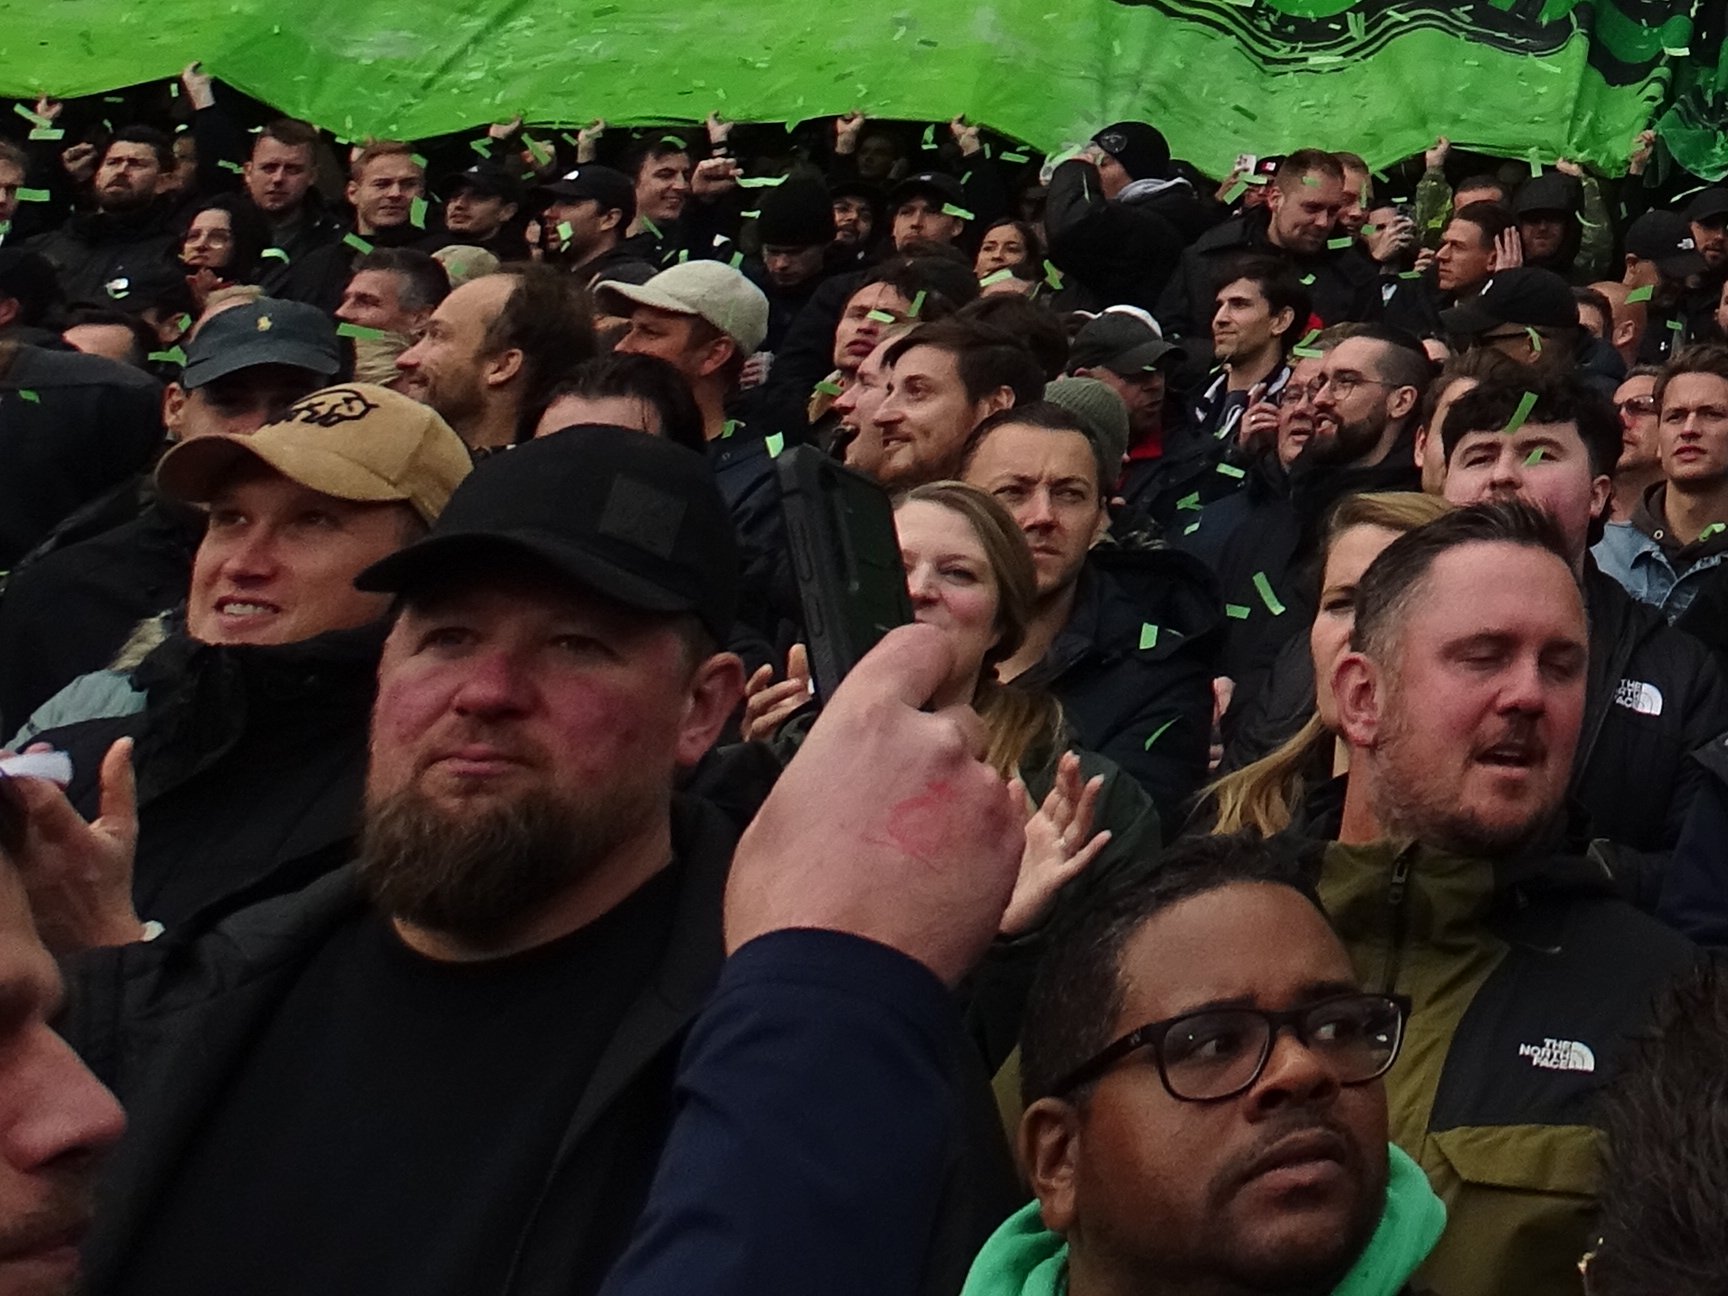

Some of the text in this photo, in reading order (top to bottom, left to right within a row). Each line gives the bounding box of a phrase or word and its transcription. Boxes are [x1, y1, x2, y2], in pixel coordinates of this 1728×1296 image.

[1519, 1042, 1570, 1060] NORTH
[1543, 1037, 1571, 1051] THE
[1532, 1055, 1569, 1070] FACE
